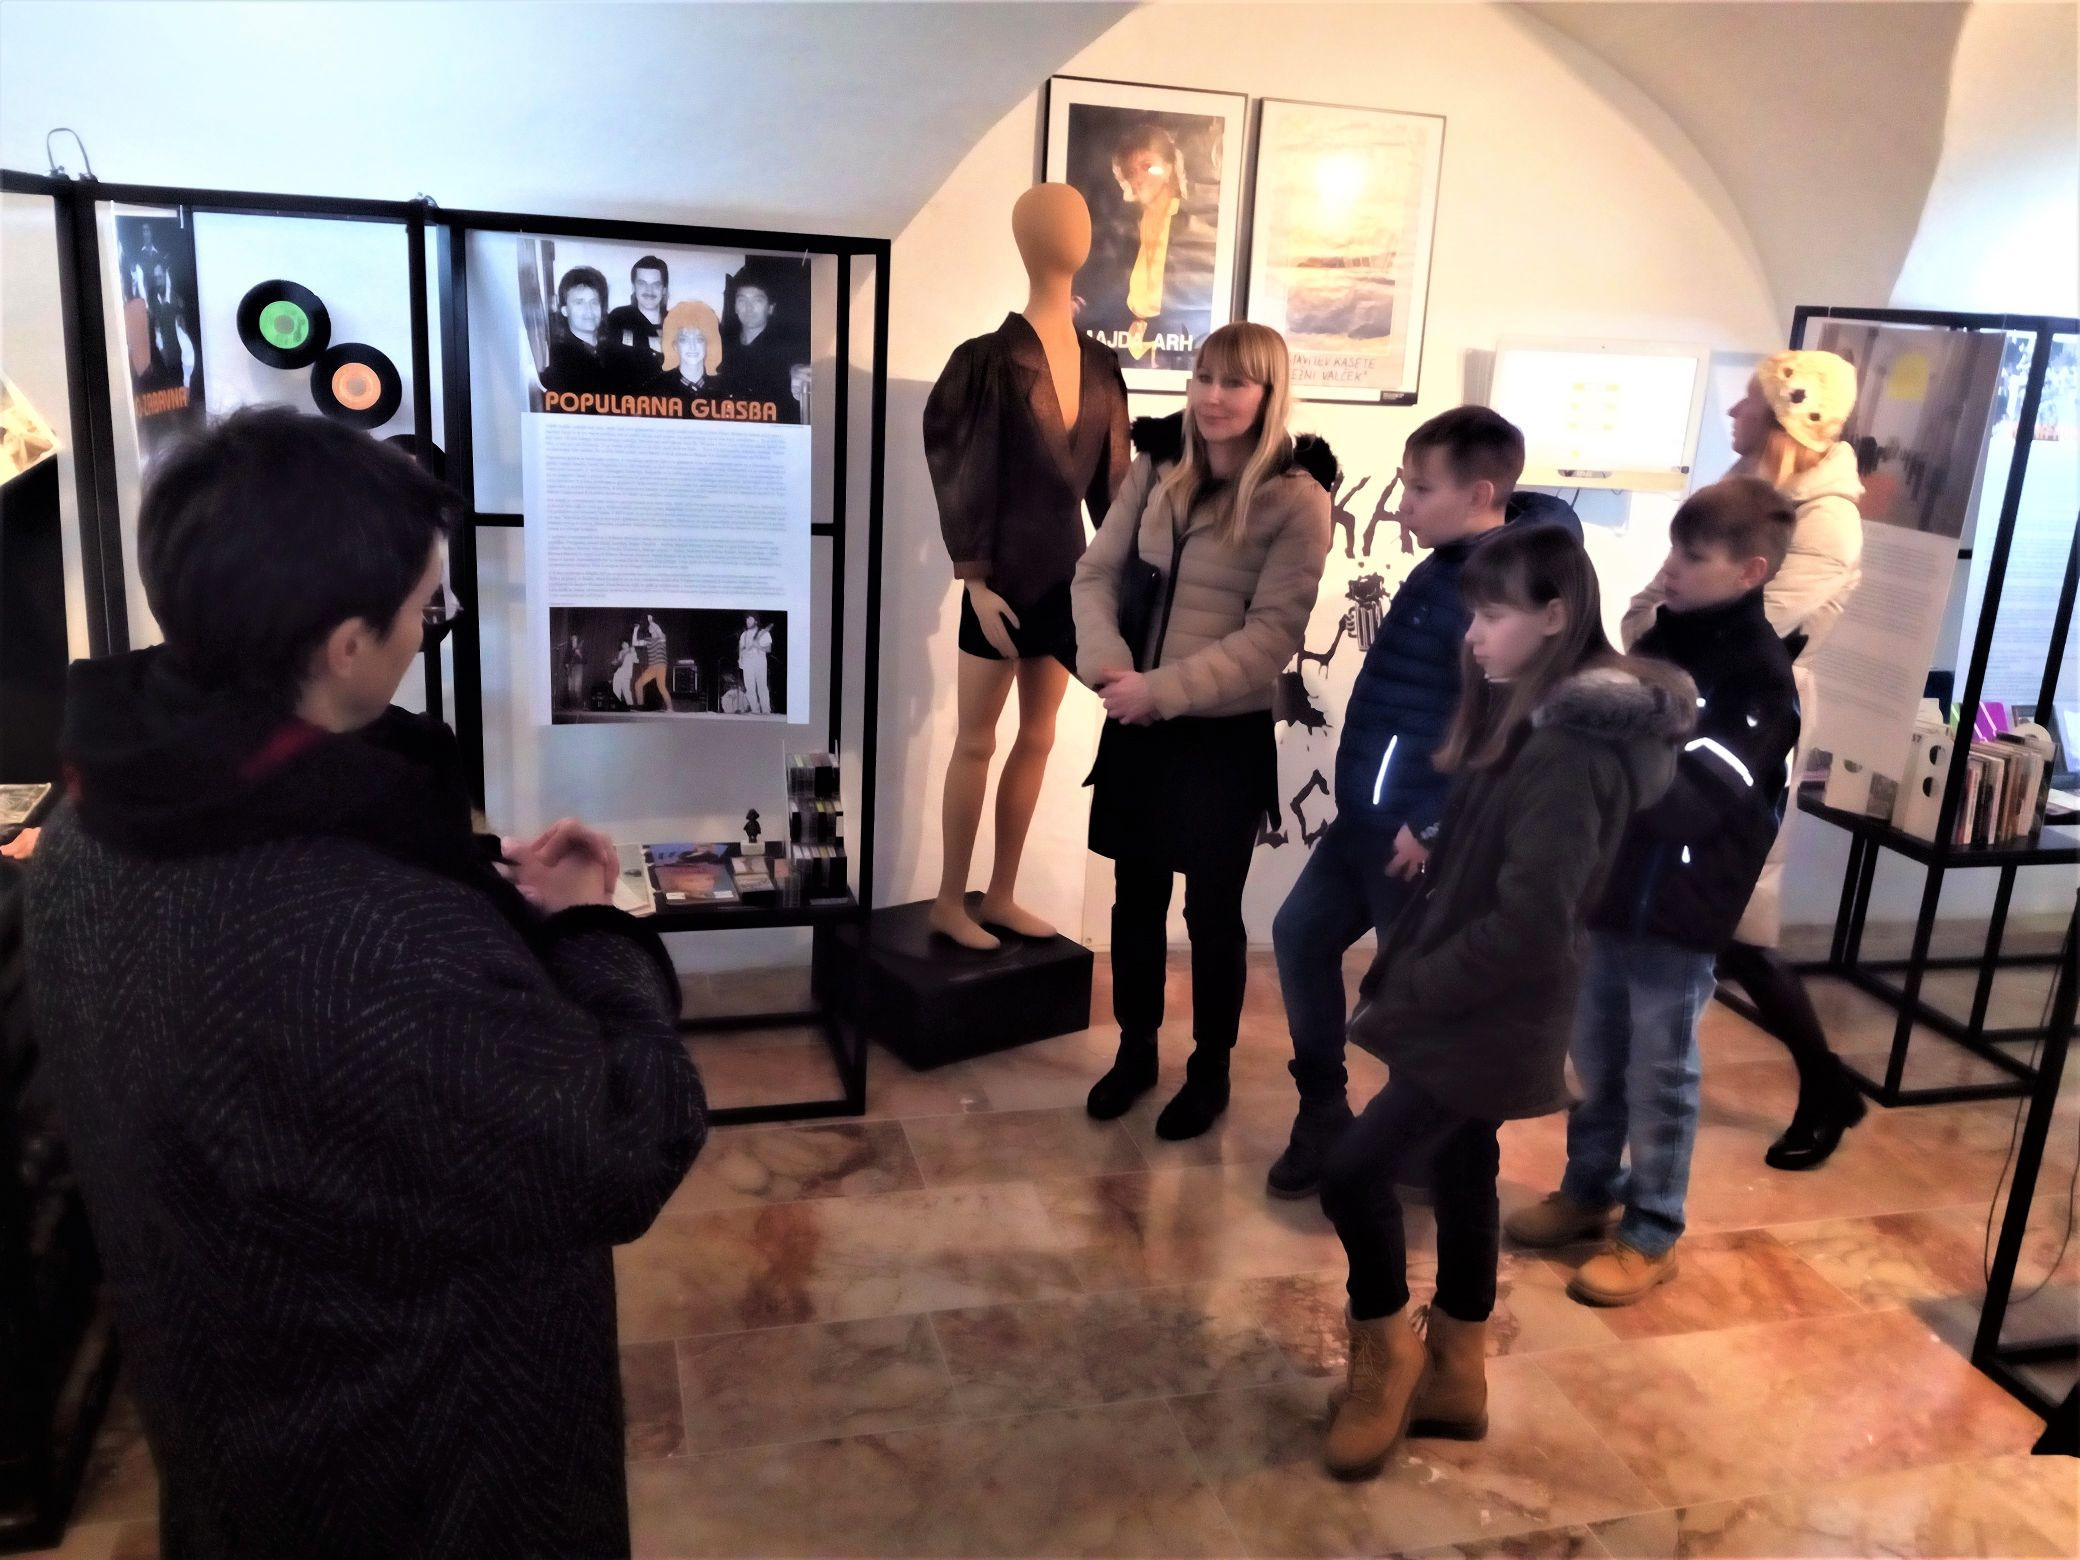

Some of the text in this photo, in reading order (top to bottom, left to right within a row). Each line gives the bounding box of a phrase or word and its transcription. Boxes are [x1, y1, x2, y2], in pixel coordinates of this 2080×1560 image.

[1153, 333, 1193, 351] ARH
[545, 391, 777, 421] POPULARNA GLASBA
